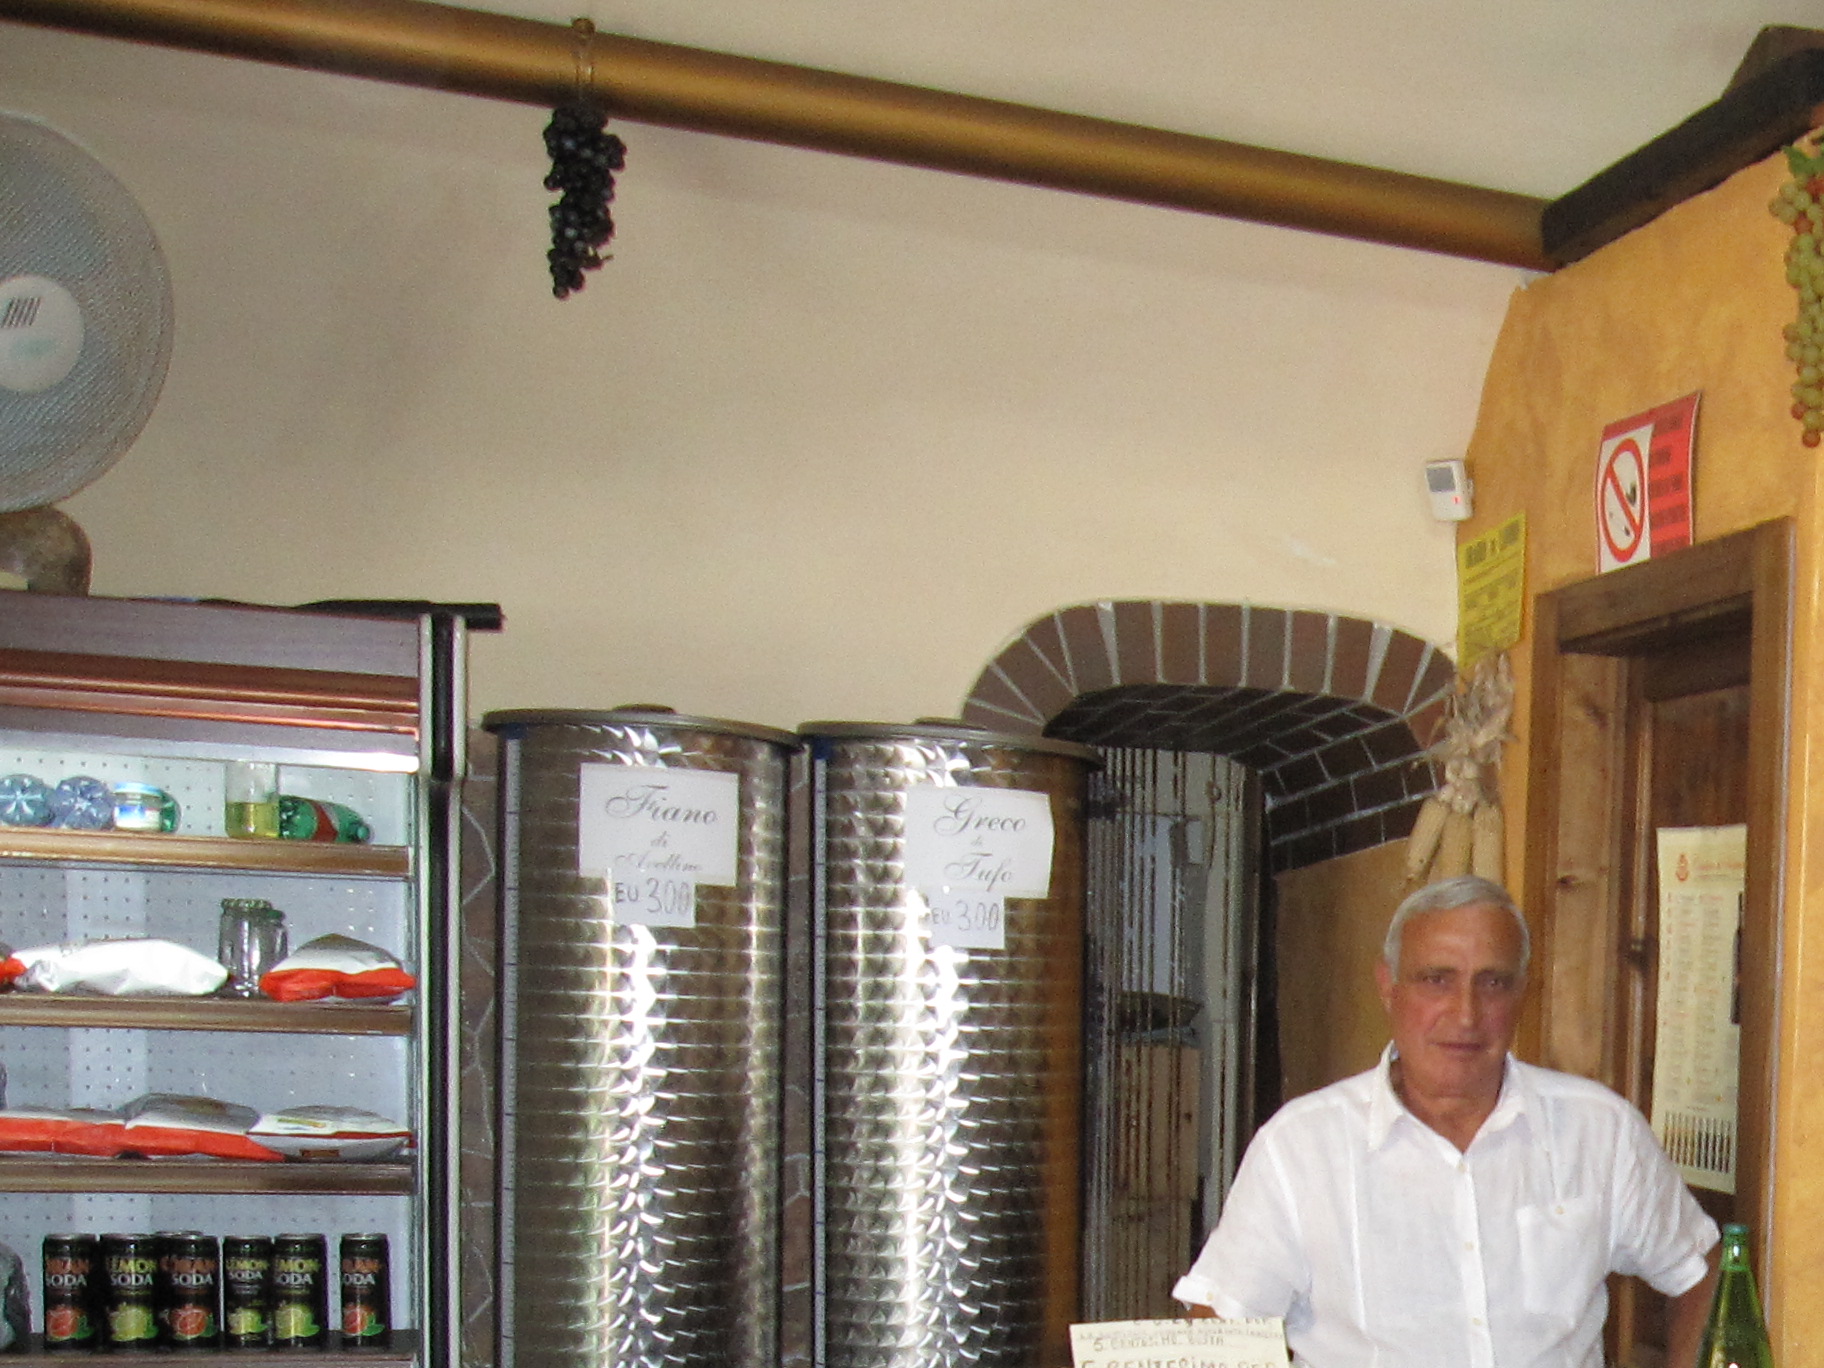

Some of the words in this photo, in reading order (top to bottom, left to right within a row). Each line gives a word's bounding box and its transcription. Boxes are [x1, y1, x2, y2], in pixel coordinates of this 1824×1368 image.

[605, 784, 719, 825] Fiano
[933, 794, 1027, 837] Greco
[944, 852, 1014, 893] Tufo
[110, 1274, 154, 1287] SODA
[171, 1274, 214, 1287] SODA
